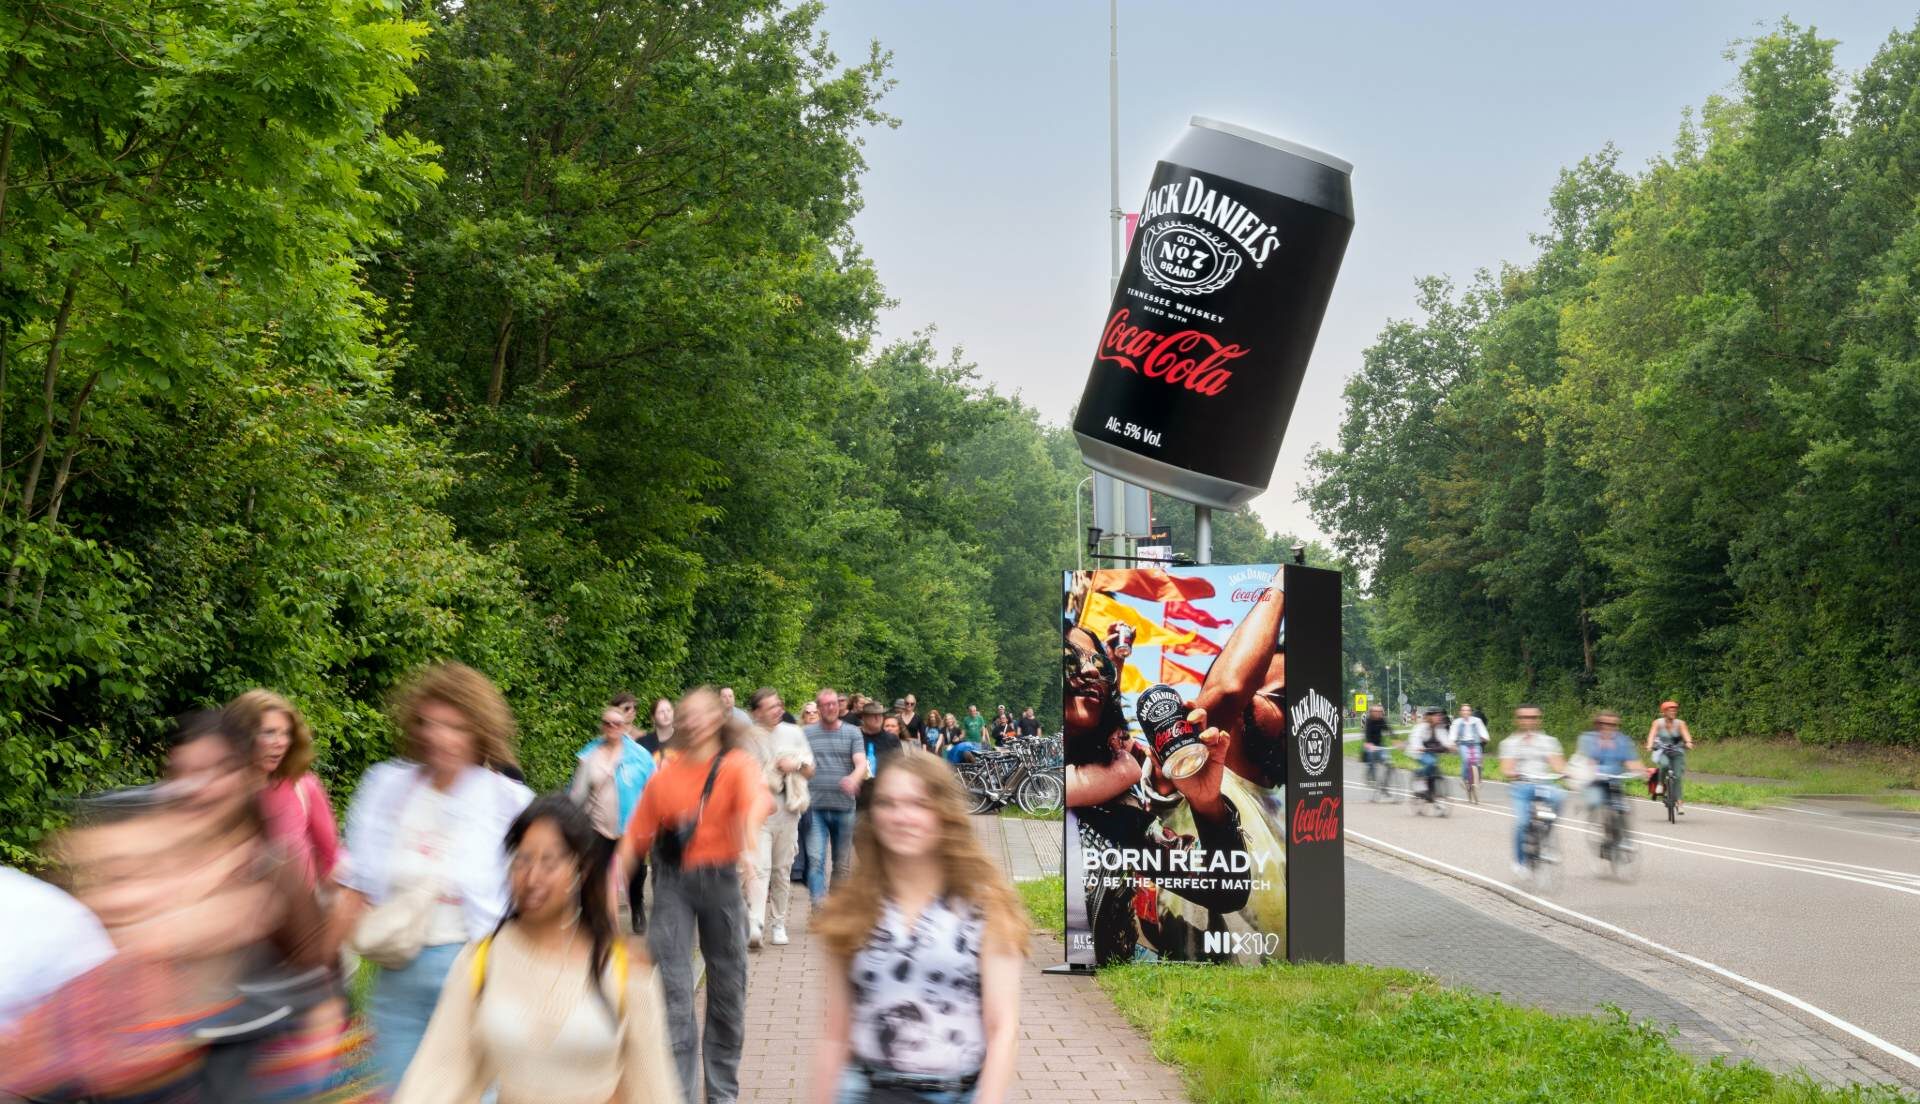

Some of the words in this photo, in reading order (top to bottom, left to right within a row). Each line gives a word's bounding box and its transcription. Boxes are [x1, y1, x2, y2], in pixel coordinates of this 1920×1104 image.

[1139, 183, 1183, 228] JACK
[1181, 175, 1281, 264] DANIEL'S
[1176, 235, 1197, 247] OLD
[1160, 261, 1197, 279] BRAND
[1127, 287, 1172, 307] TENNESSEE
[1175, 302, 1225, 324] WHISKEY
[1143, 305, 1165, 316] MIXED
[1167, 312, 1188, 323] WITH
[1105, 416, 1122, 434] Alc.
[1123, 422, 1142, 440] 5%
[1143, 428, 1162, 448] Vol.
[1140, 699, 1154, 721] JACK
[1290, 695, 1310, 737] JACK
[1309, 688, 1340, 740] DANIEL'S
[1082, 848, 1162, 872] BORN
[1169, 849, 1271, 873] READY
[1081, 876, 1099, 888] TO
[1103, 876, 1121, 888] BE
[1125, 877, 1151, 888] THE
[1155, 877, 1218, 890] PERFECT
[1221, 879, 1271, 891] MATCH
[1073, 934, 1095, 945] ALC.
